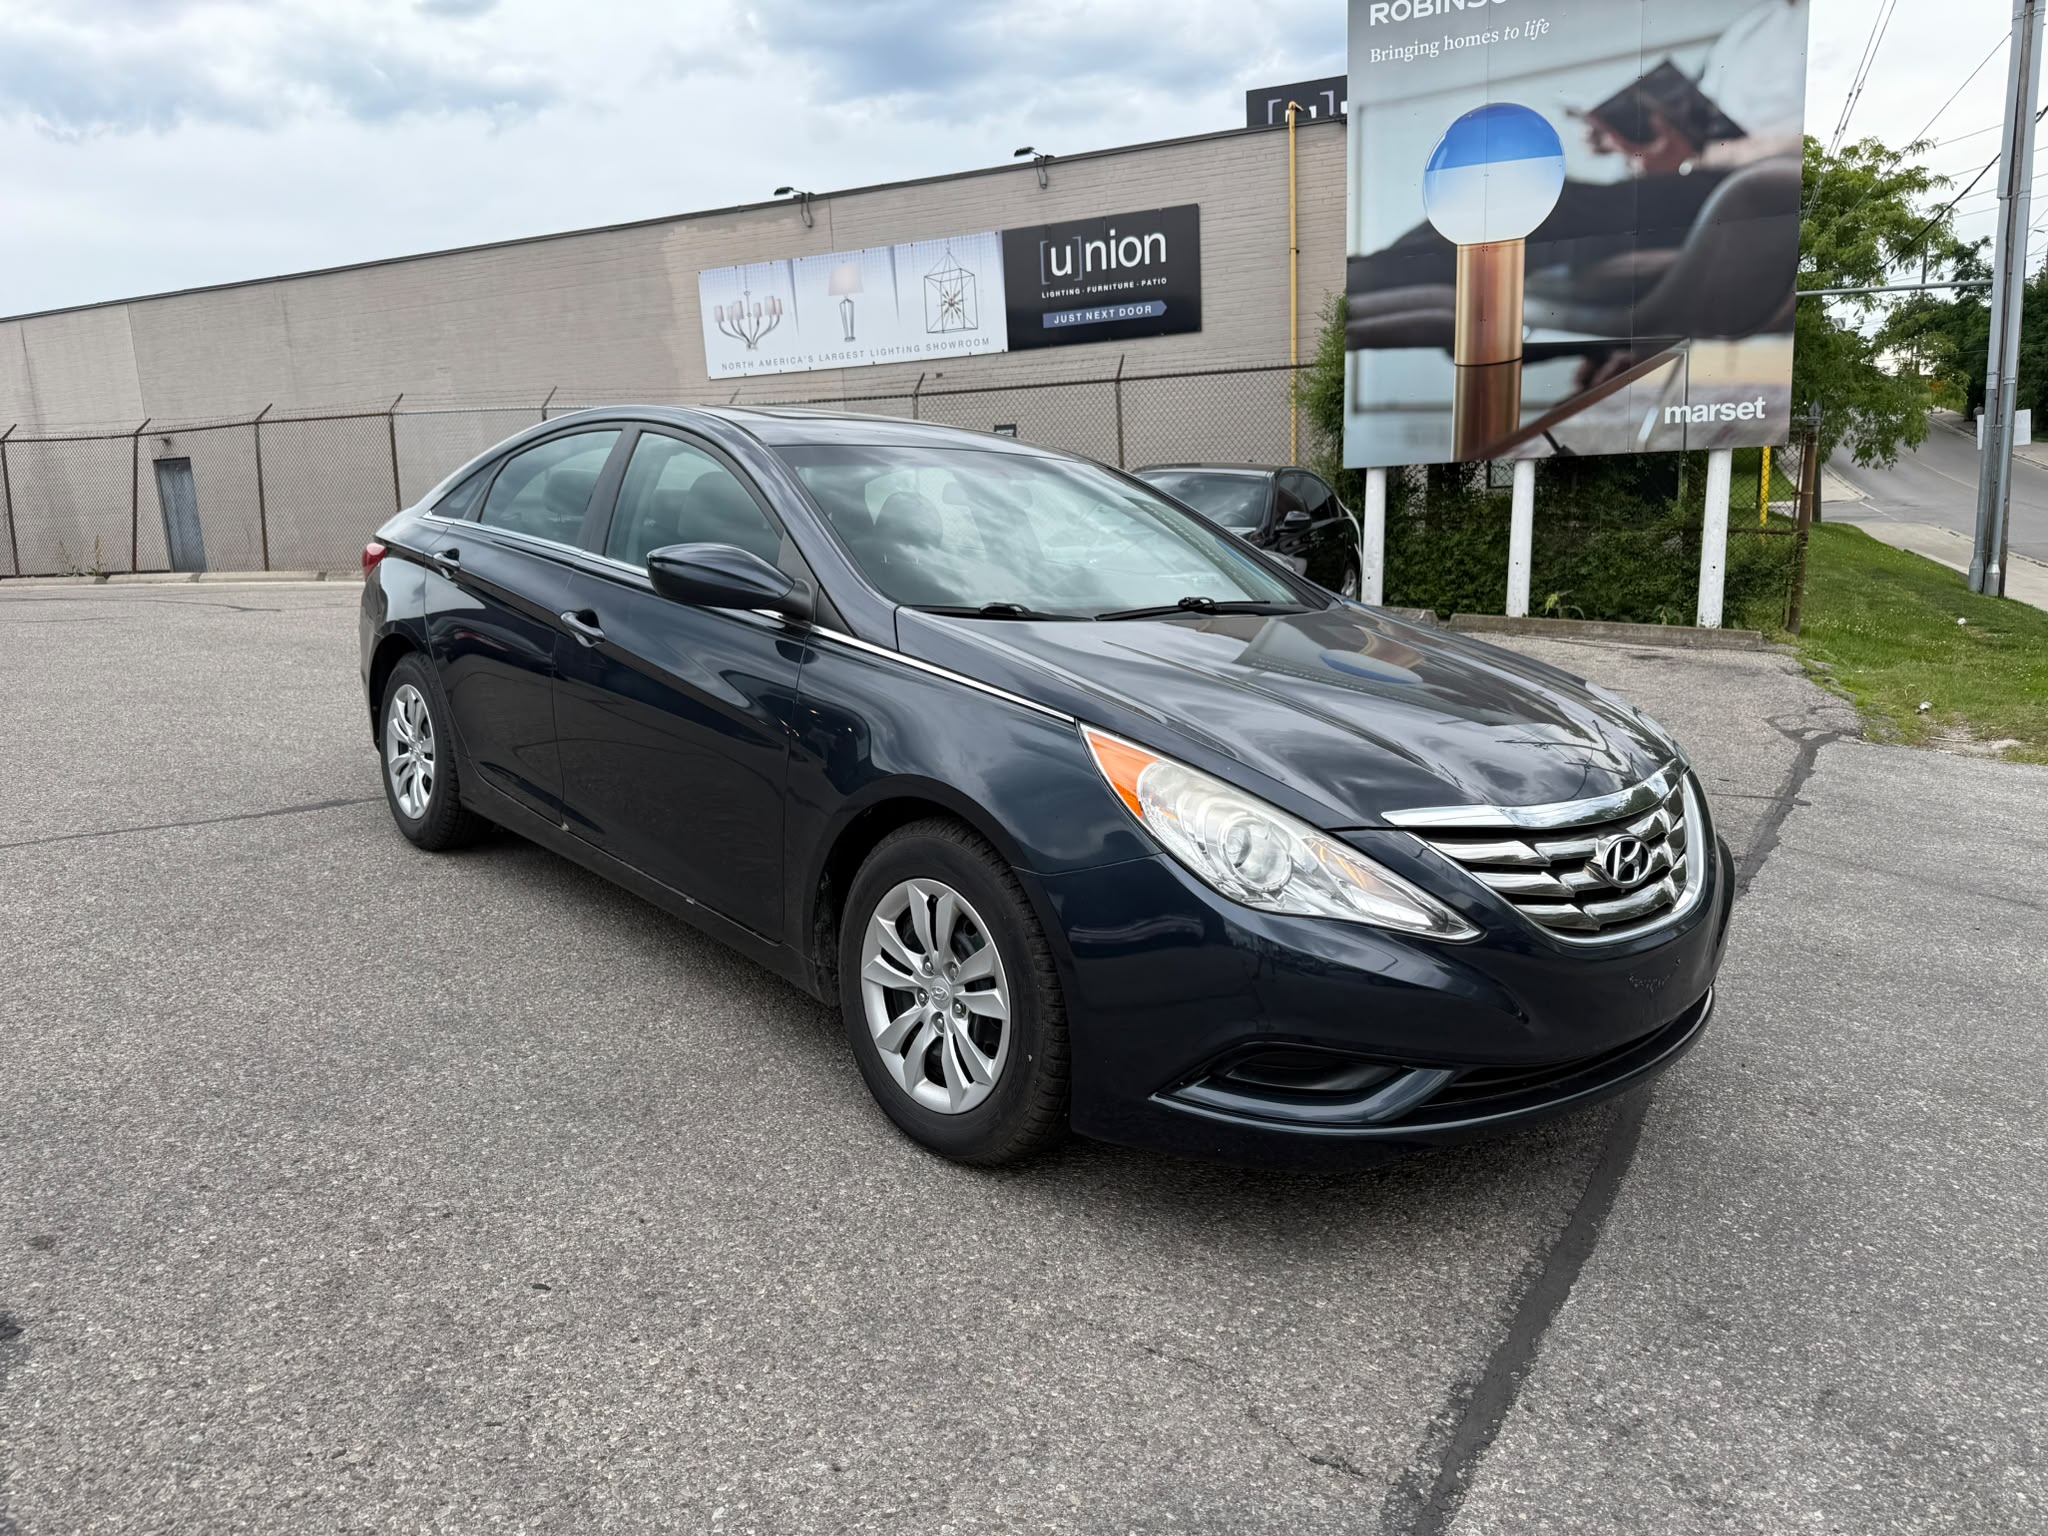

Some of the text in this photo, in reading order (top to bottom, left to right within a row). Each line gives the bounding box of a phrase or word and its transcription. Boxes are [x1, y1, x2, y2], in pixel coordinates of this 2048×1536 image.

[1370, 0, 1507, 26] ROBIN
[1370, 18, 1550, 63] Bringing homes to life
[1041, 277, 1168, 299] LIGHTING FURNITURE PATIO
[1054, 305, 1152, 324] JUST NEXT DOOR
[721, 338, 990, 371] NORTH AMERICA'S LARGEST LIGHTING SHOWROOM
[1664, 396, 1767, 425] marset
